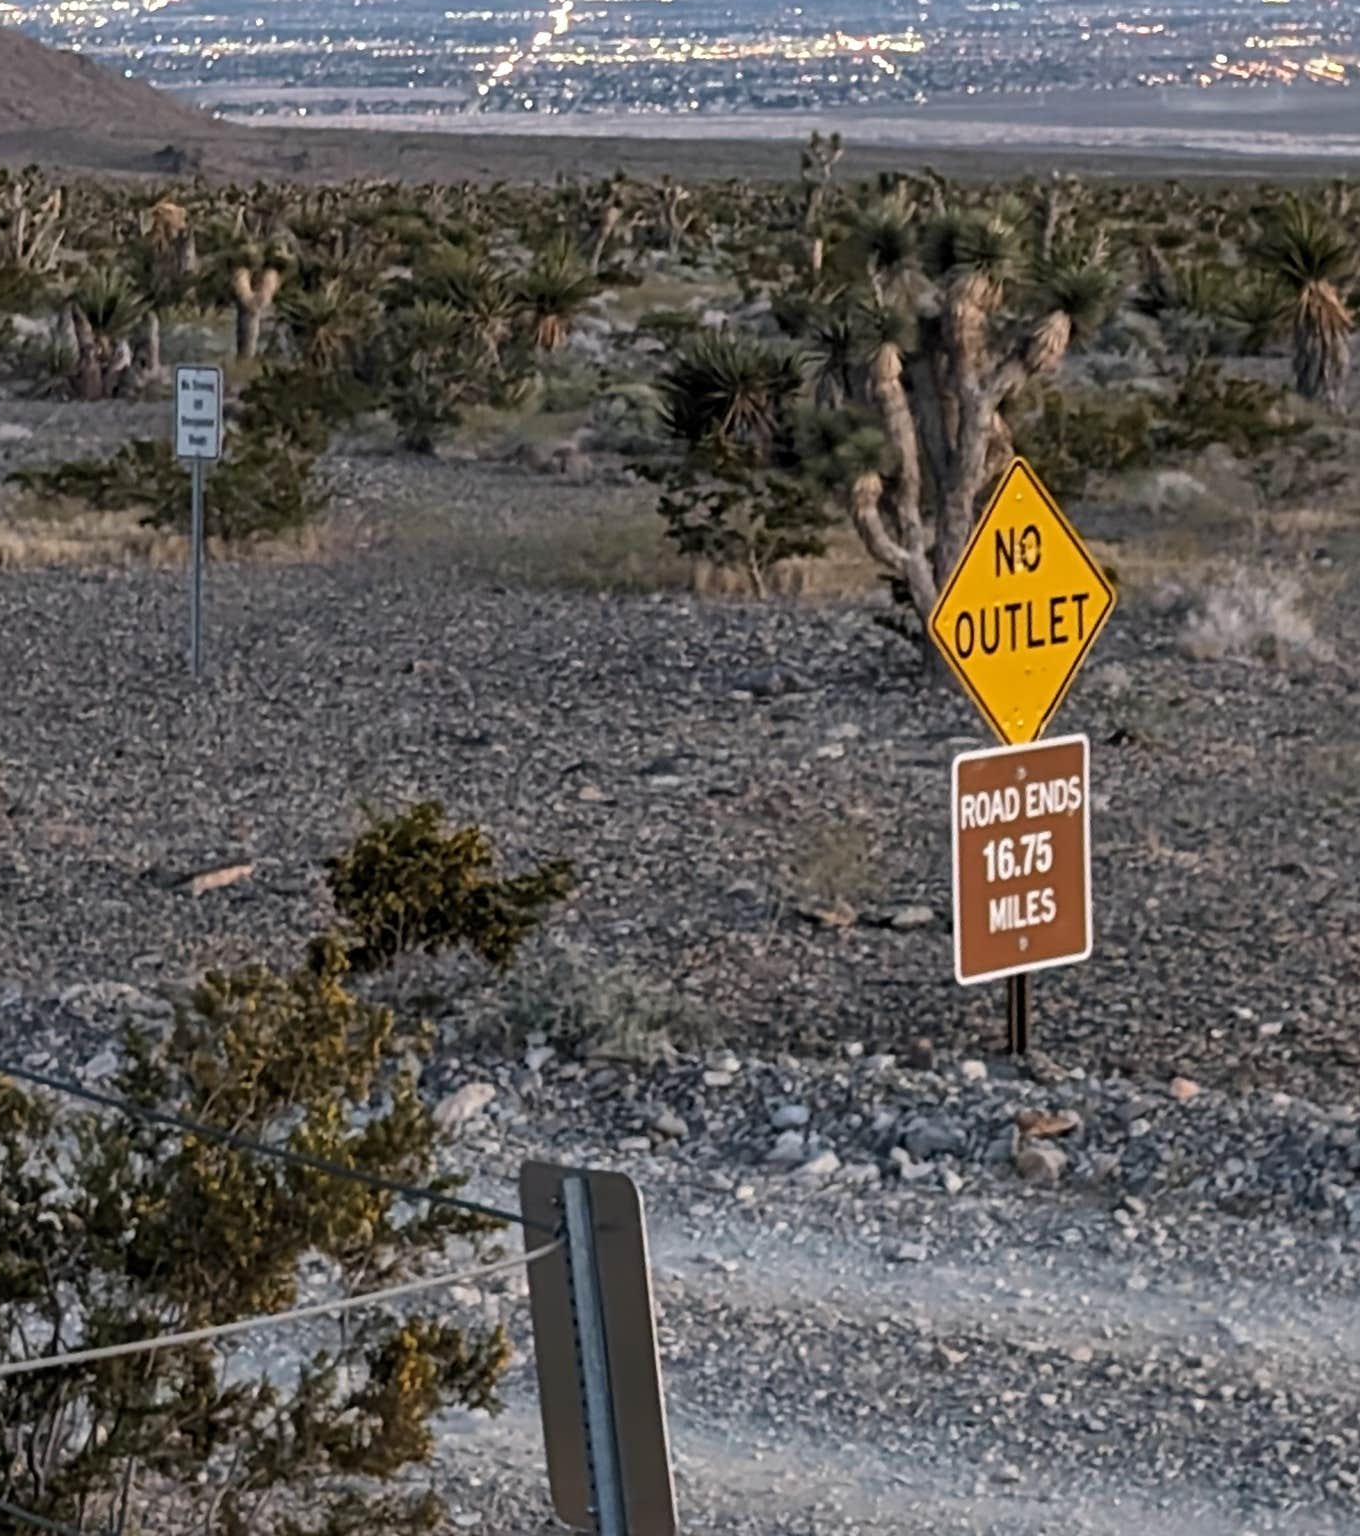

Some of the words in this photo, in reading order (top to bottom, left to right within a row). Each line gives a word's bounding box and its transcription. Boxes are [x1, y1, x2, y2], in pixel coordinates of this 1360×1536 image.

[995, 524, 1042, 578] NO
[955, 593, 1090, 660] OUTLET
[960, 785, 1020, 830] ROAD
[1026, 776, 1082, 818] ENDS
[983, 831, 1054, 883] 16.75
[989, 887, 1057, 934] MILES
